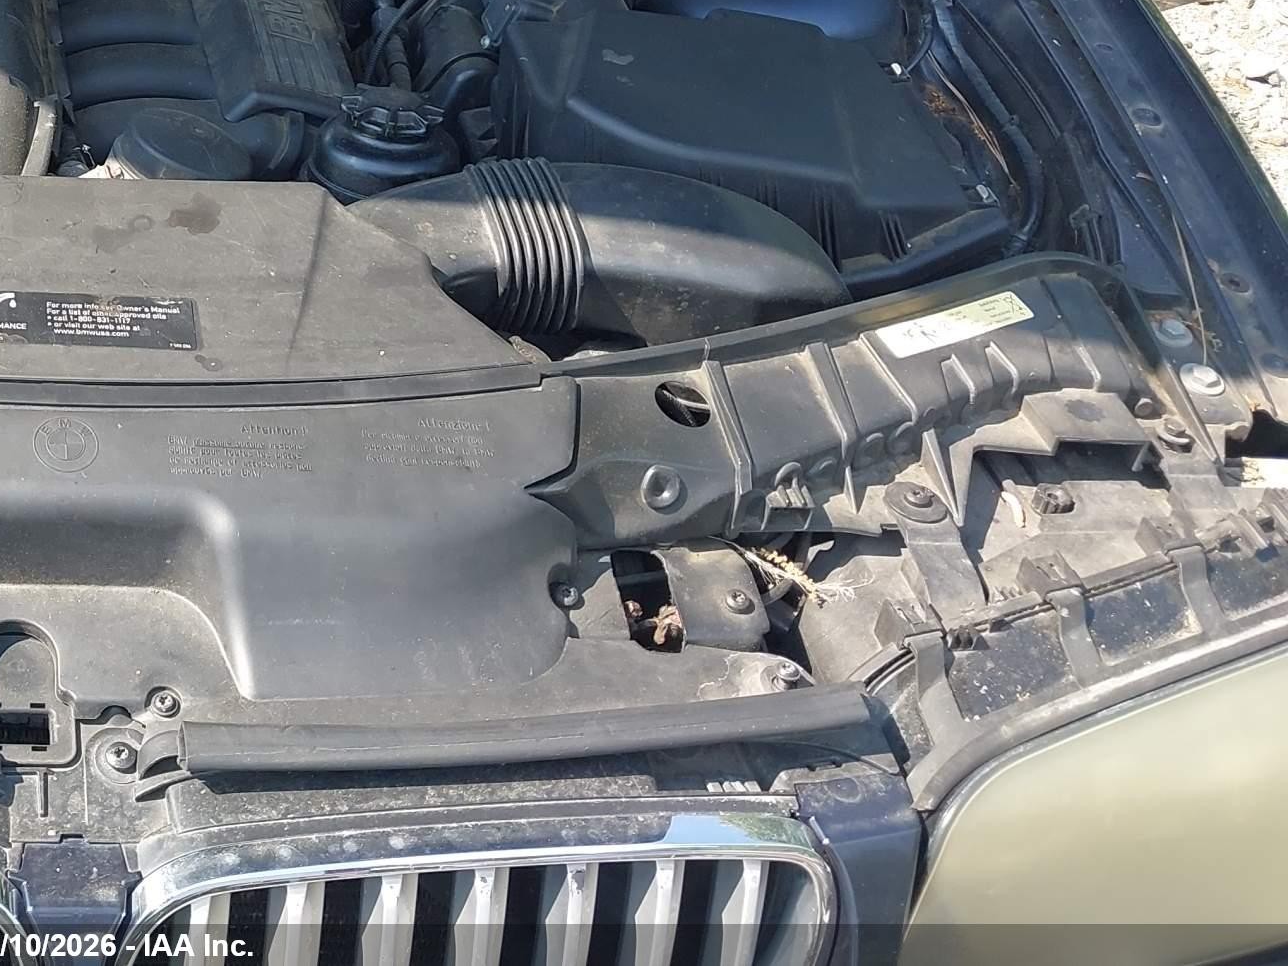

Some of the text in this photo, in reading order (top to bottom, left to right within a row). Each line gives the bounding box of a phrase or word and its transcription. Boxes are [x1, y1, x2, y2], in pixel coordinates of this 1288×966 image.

[46, 301, 60, 309] For
[84, 302, 99, 310] info
[116, 304, 150, 313] Owner's
[150, 306, 181, 314] Manual
[69, 315, 131, 324] 1-800-831-1117
[152, 313, 168, 321] oils
[64, 321, 81, 329] visit
[97, 323, 115, 331] web
[116, 323, 132, 332] site
[132, 324, 141, 332] at
[53, 328, 130, 337] www.bmwusa.com
[240, 424, 298, 436] Attention
